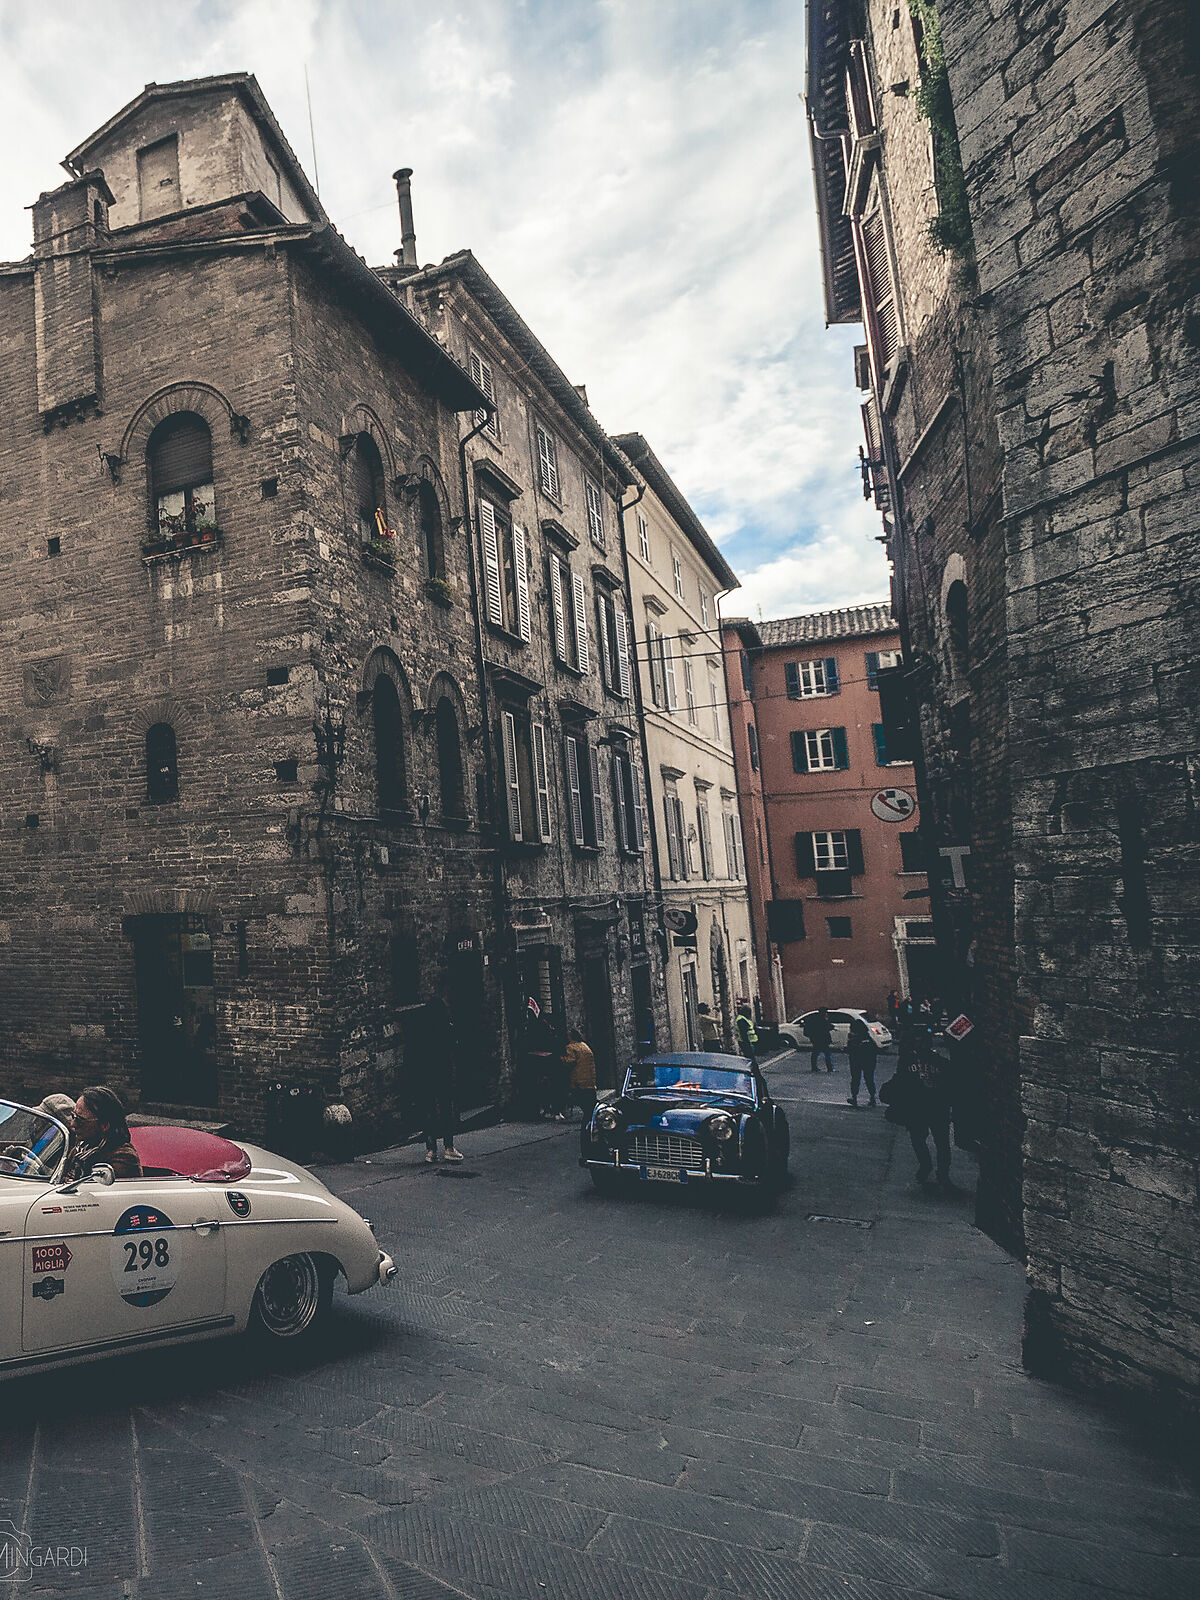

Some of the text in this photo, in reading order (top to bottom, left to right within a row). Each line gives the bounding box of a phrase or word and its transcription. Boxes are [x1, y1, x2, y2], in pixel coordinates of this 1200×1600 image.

[35, 1247, 63, 1259] 1000
[123, 1237, 170, 1273] 298
[34, 1258, 65, 1271] MIGLIA
